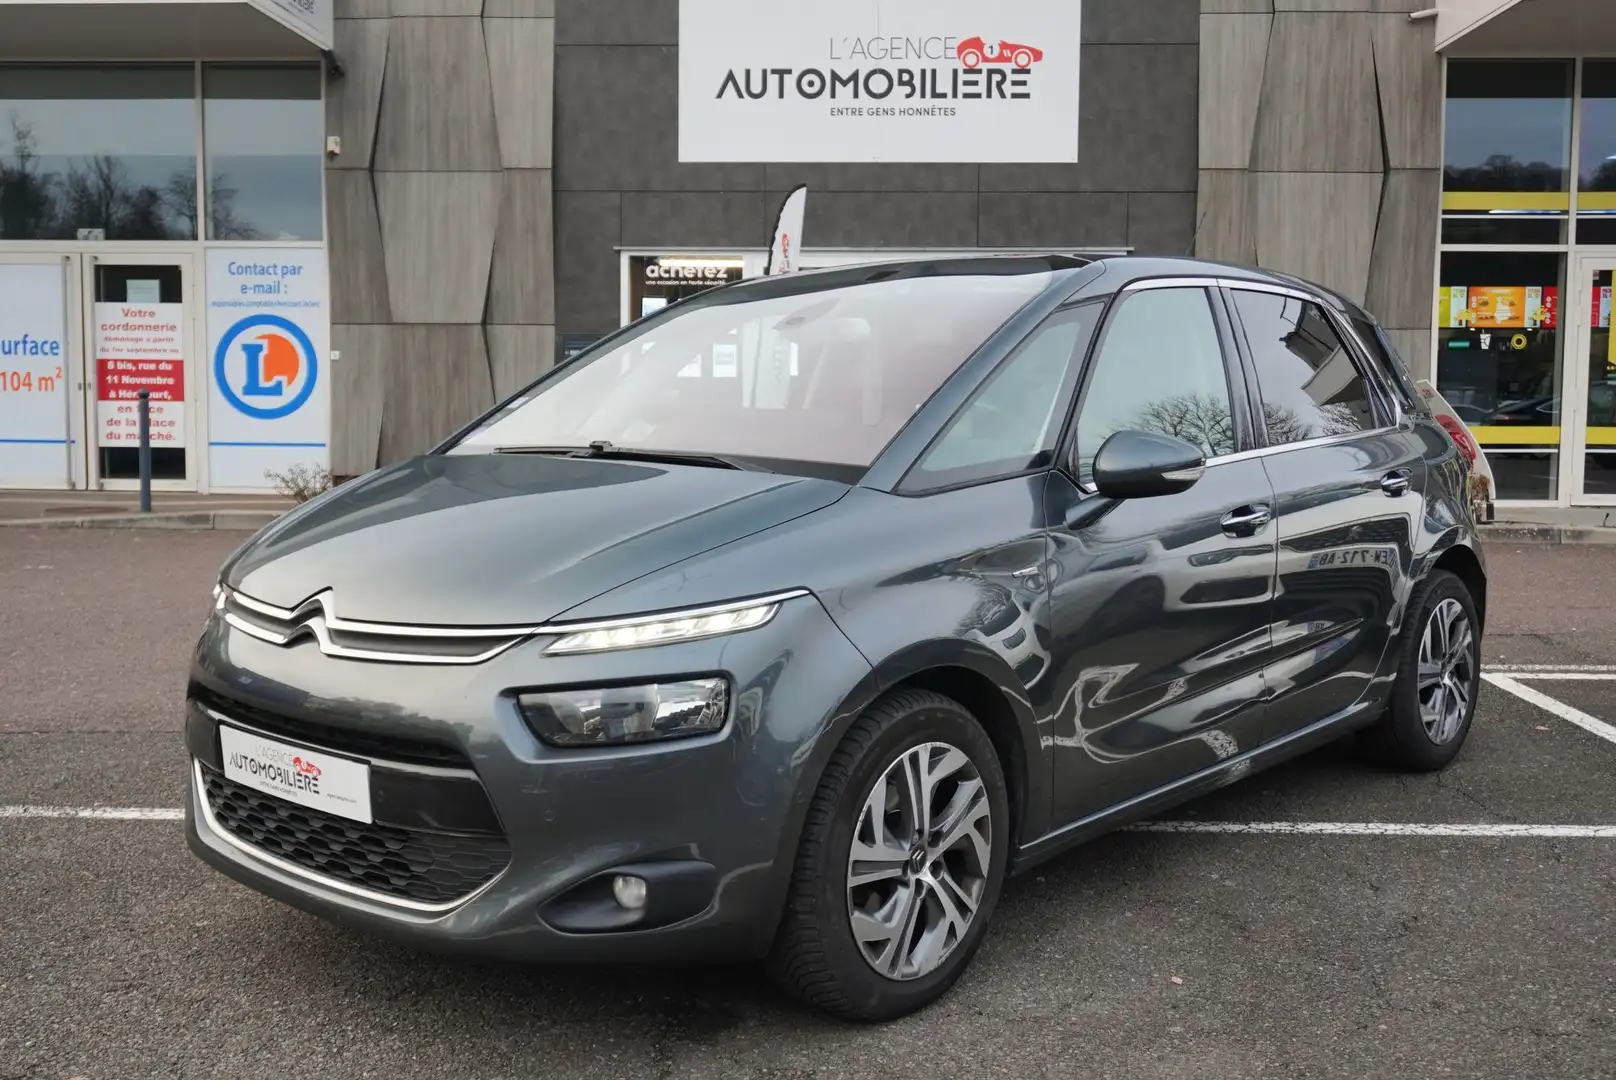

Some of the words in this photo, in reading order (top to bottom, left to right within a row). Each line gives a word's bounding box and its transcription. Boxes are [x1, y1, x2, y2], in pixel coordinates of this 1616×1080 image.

[830, 36, 957, 60] L'AGENCE
[830, 107, 864, 116] ENTRE
[867, 107, 895, 116] GENS
[228, 262, 278, 276] Contact
[281, 265, 303, 279] par
[645, 264, 728, 278] achetez
[240, 281, 280, 294] e-mail
[121, 308, 156, 318] Votre
[100, 322, 177, 332] cordonnerie
[1, 333, 60, 356] urface
[116, 360, 136, 372] bis,
[138, 362, 157, 370] rue
[158, 361, 173, 370] du
[0, 371, 33, 392] 104
[106, 374, 119, 384] 11
[121, 374, 175, 385] Novembre
[118, 388, 172, 400] Hérourt,
[106, 417, 120, 427] de
[126, 417, 136, 427] la
[142, 417, 176, 428] lace
[106, 431, 121, 441] du
[125, 431, 176, 441] mché.
